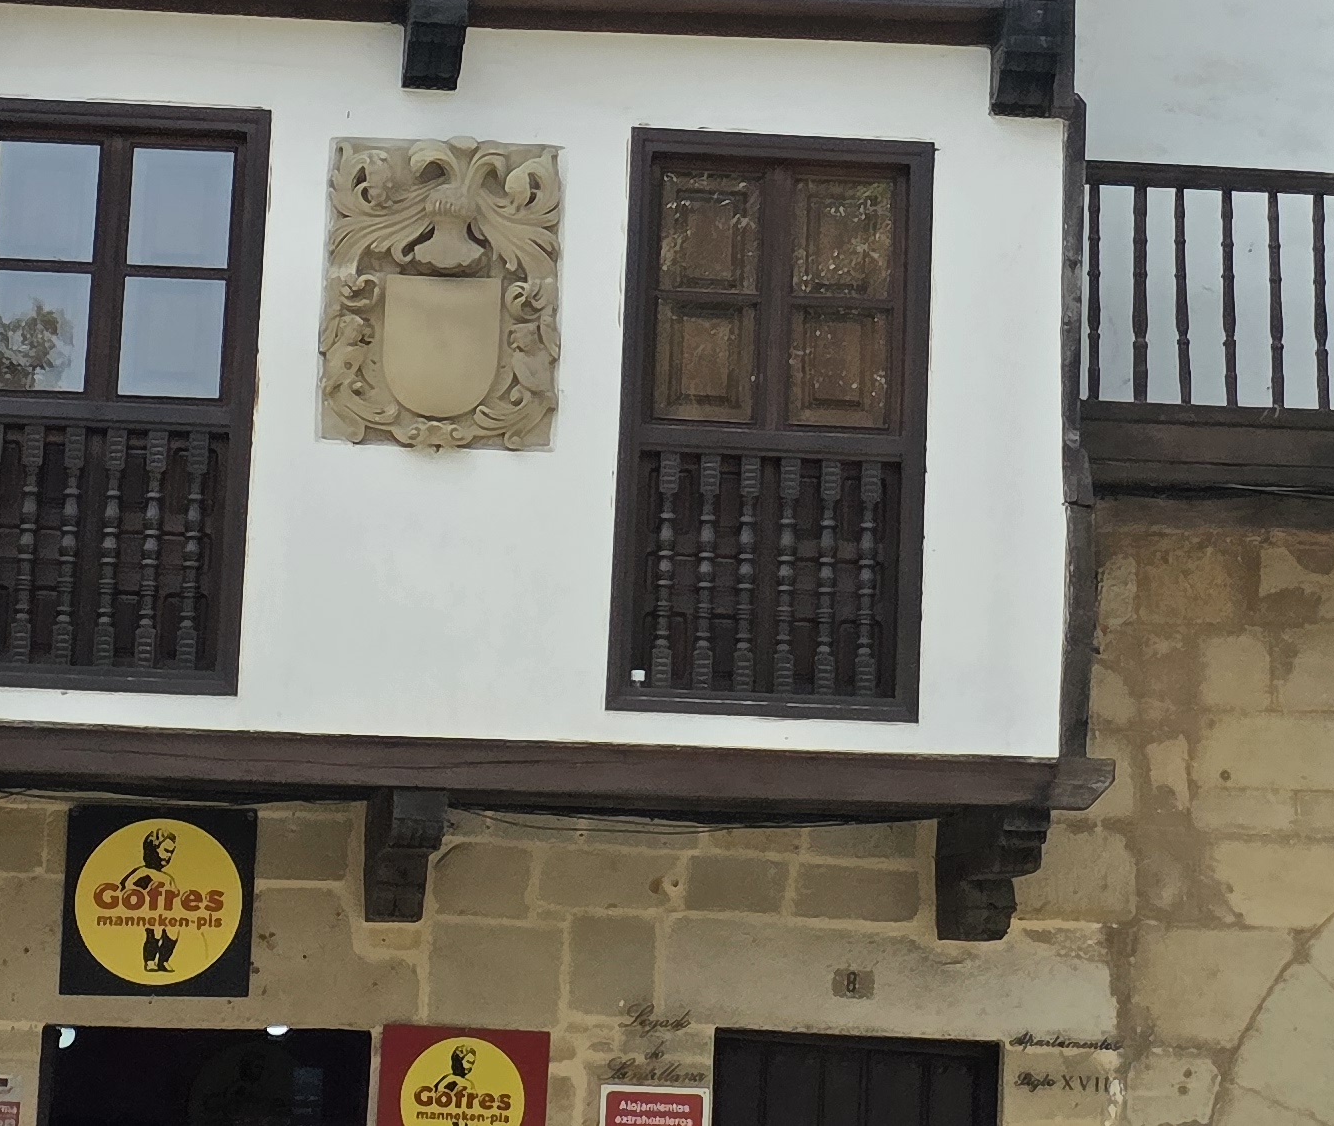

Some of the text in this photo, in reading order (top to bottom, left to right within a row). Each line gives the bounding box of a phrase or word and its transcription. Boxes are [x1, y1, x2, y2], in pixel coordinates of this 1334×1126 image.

[93, 881, 224, 912] Gofres
[96, 913, 223, 931] manneken-pis
[617, 1003, 692, 1038] Legado
[414, 1085, 512, 1111] Gofres
[619, 1100, 690, 1113] Alojamientos
